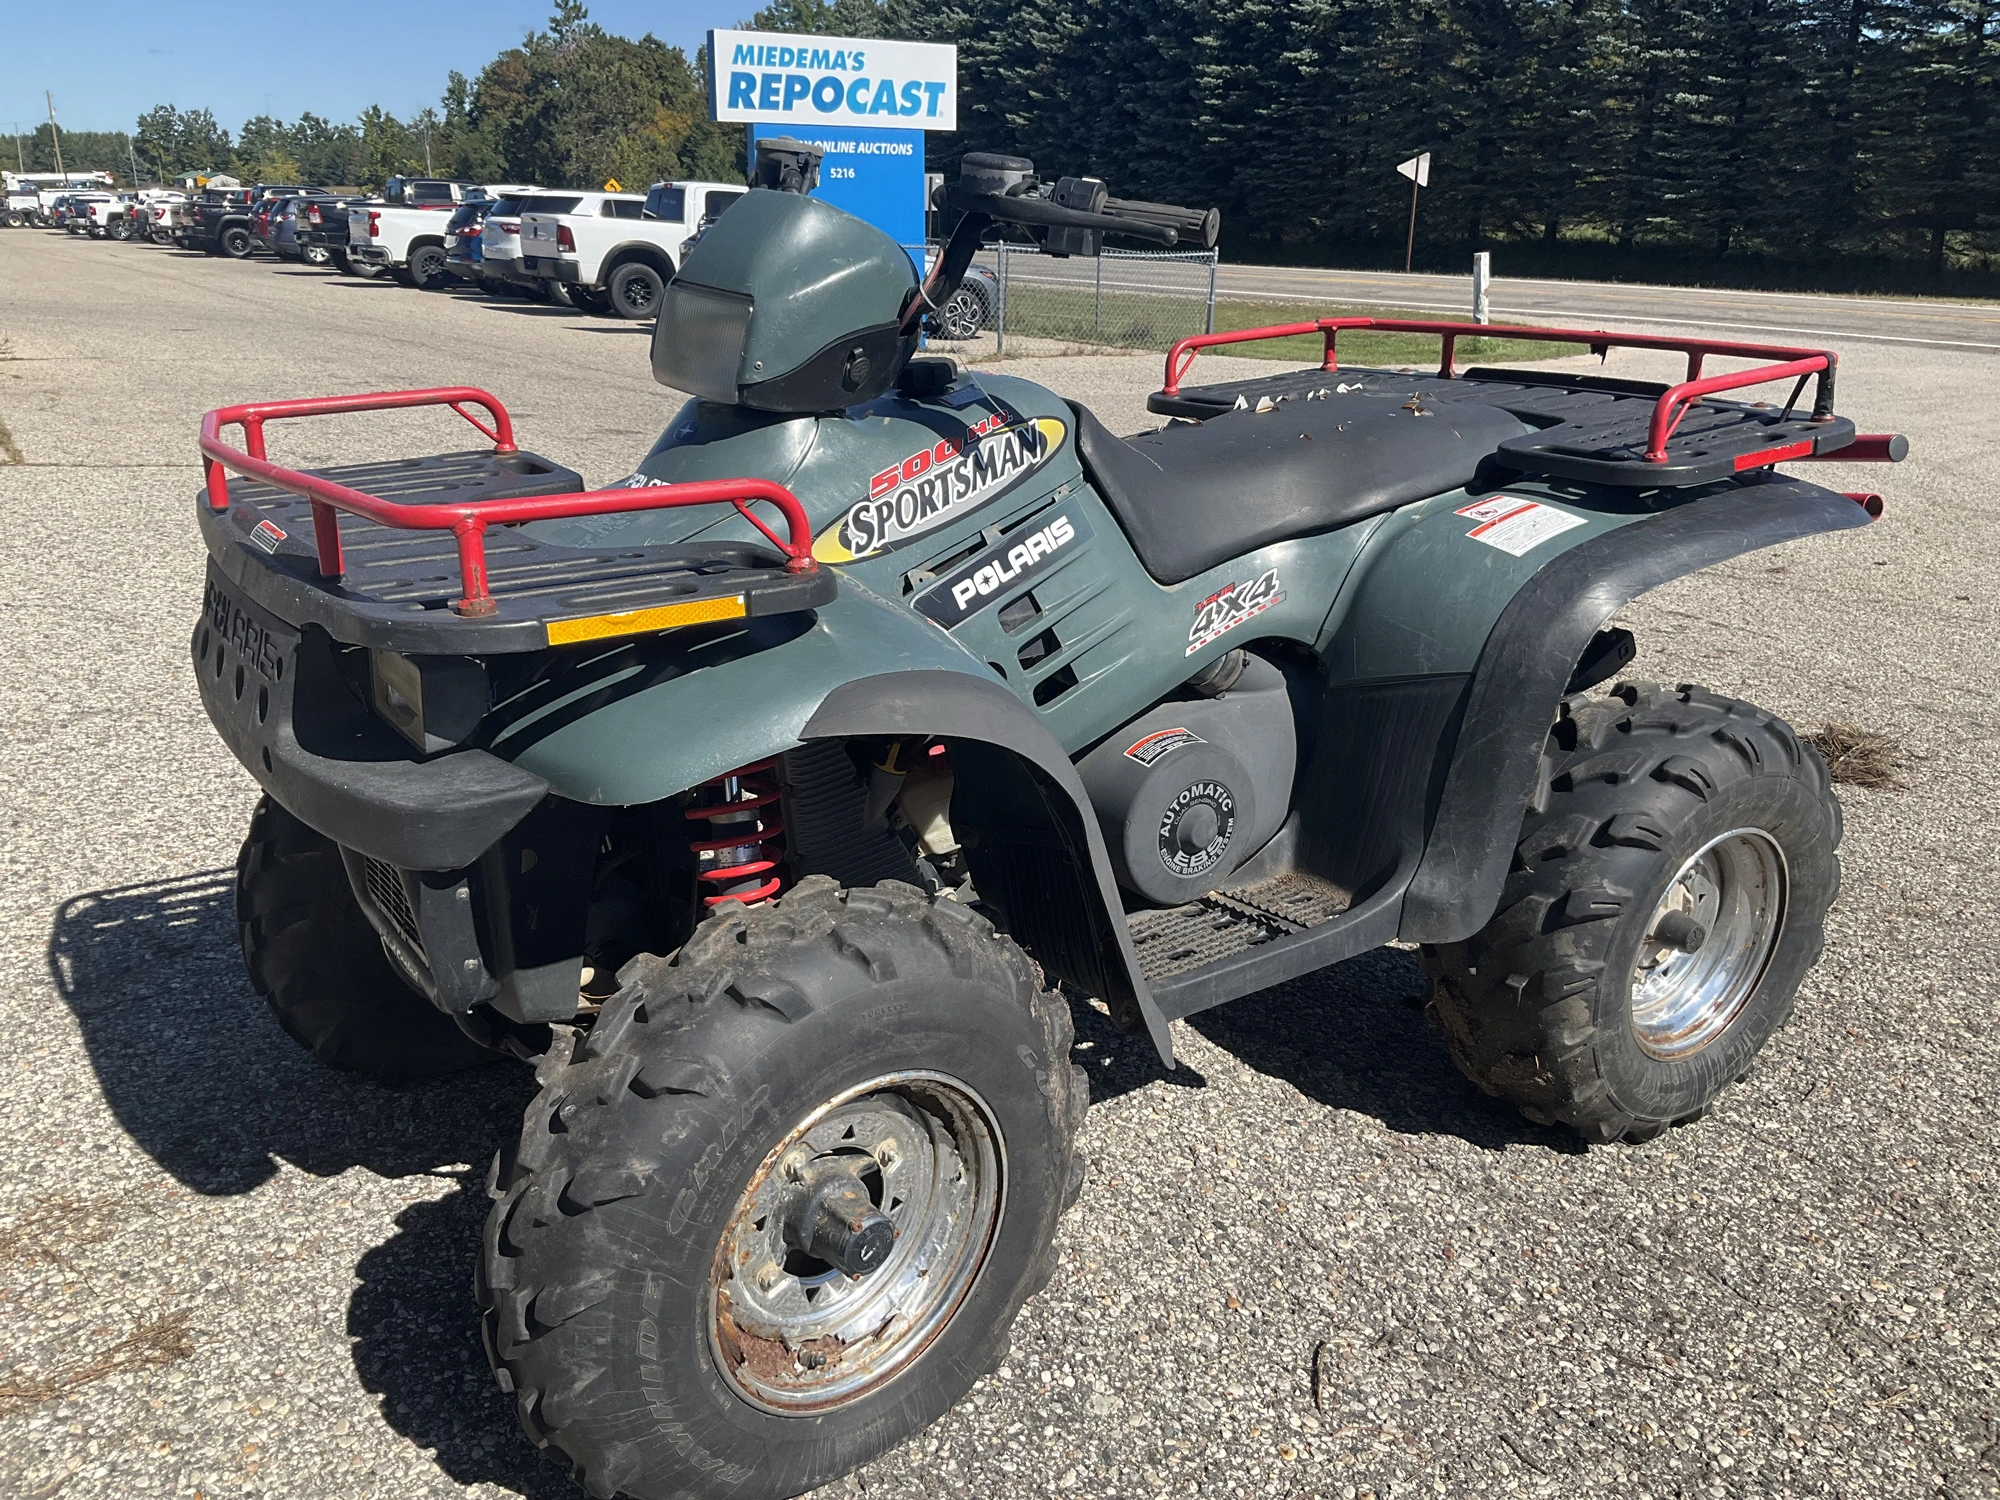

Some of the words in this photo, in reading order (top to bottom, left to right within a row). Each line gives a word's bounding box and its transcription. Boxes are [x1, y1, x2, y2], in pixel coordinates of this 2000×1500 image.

[732, 44, 866, 72] MIEDEMA'S
[727, 71, 946, 118] REPOCAST
[830, 168, 855, 178] 5216
[857, 142, 914, 156] AUCTIONS
[848, 417, 1041, 558] SPORTSMAN
[869, 436, 965, 500] 500
[951, 515, 1075, 611] POLARIS
[205, 579, 275, 682] POLARIS
[1160, 783, 1233, 837] AUTOMATIC
[1172, 834, 1224, 868] EBS
[1182, 855, 1218, 875] BRAKING
[1216, 817, 1235, 856] SYSTEM
